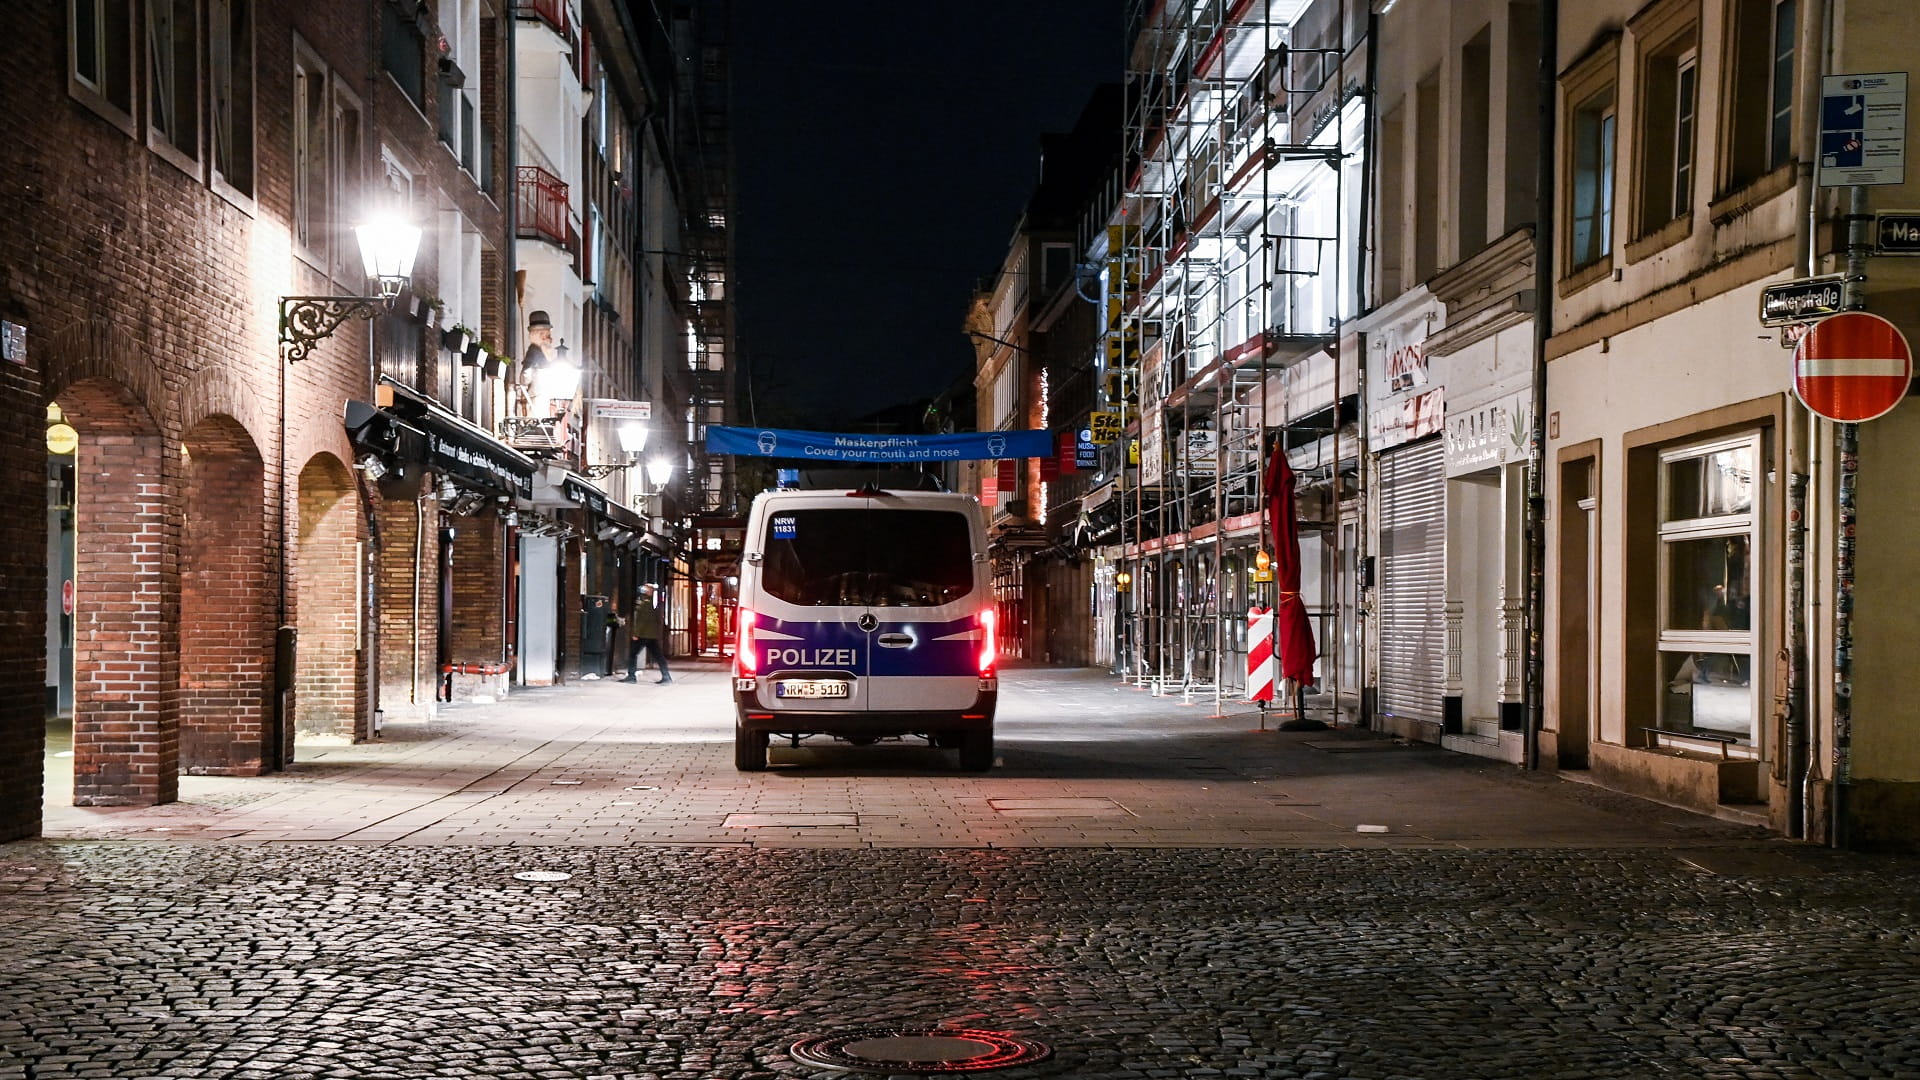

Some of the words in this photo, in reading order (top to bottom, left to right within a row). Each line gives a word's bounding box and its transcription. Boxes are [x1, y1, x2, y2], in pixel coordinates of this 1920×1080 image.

[1893, 222, 1920, 242] Ma
[834, 436, 919, 449] Maskenpflicht
[804, 446, 838, 456] Cover
[842, 449, 866, 459] your
[870, 449, 906, 459] mouth
[908, 449, 930, 458] and
[933, 449, 960, 458] nose
[774, 517, 796, 525] NRW
[767, 648, 857, 666] POLIZEI
